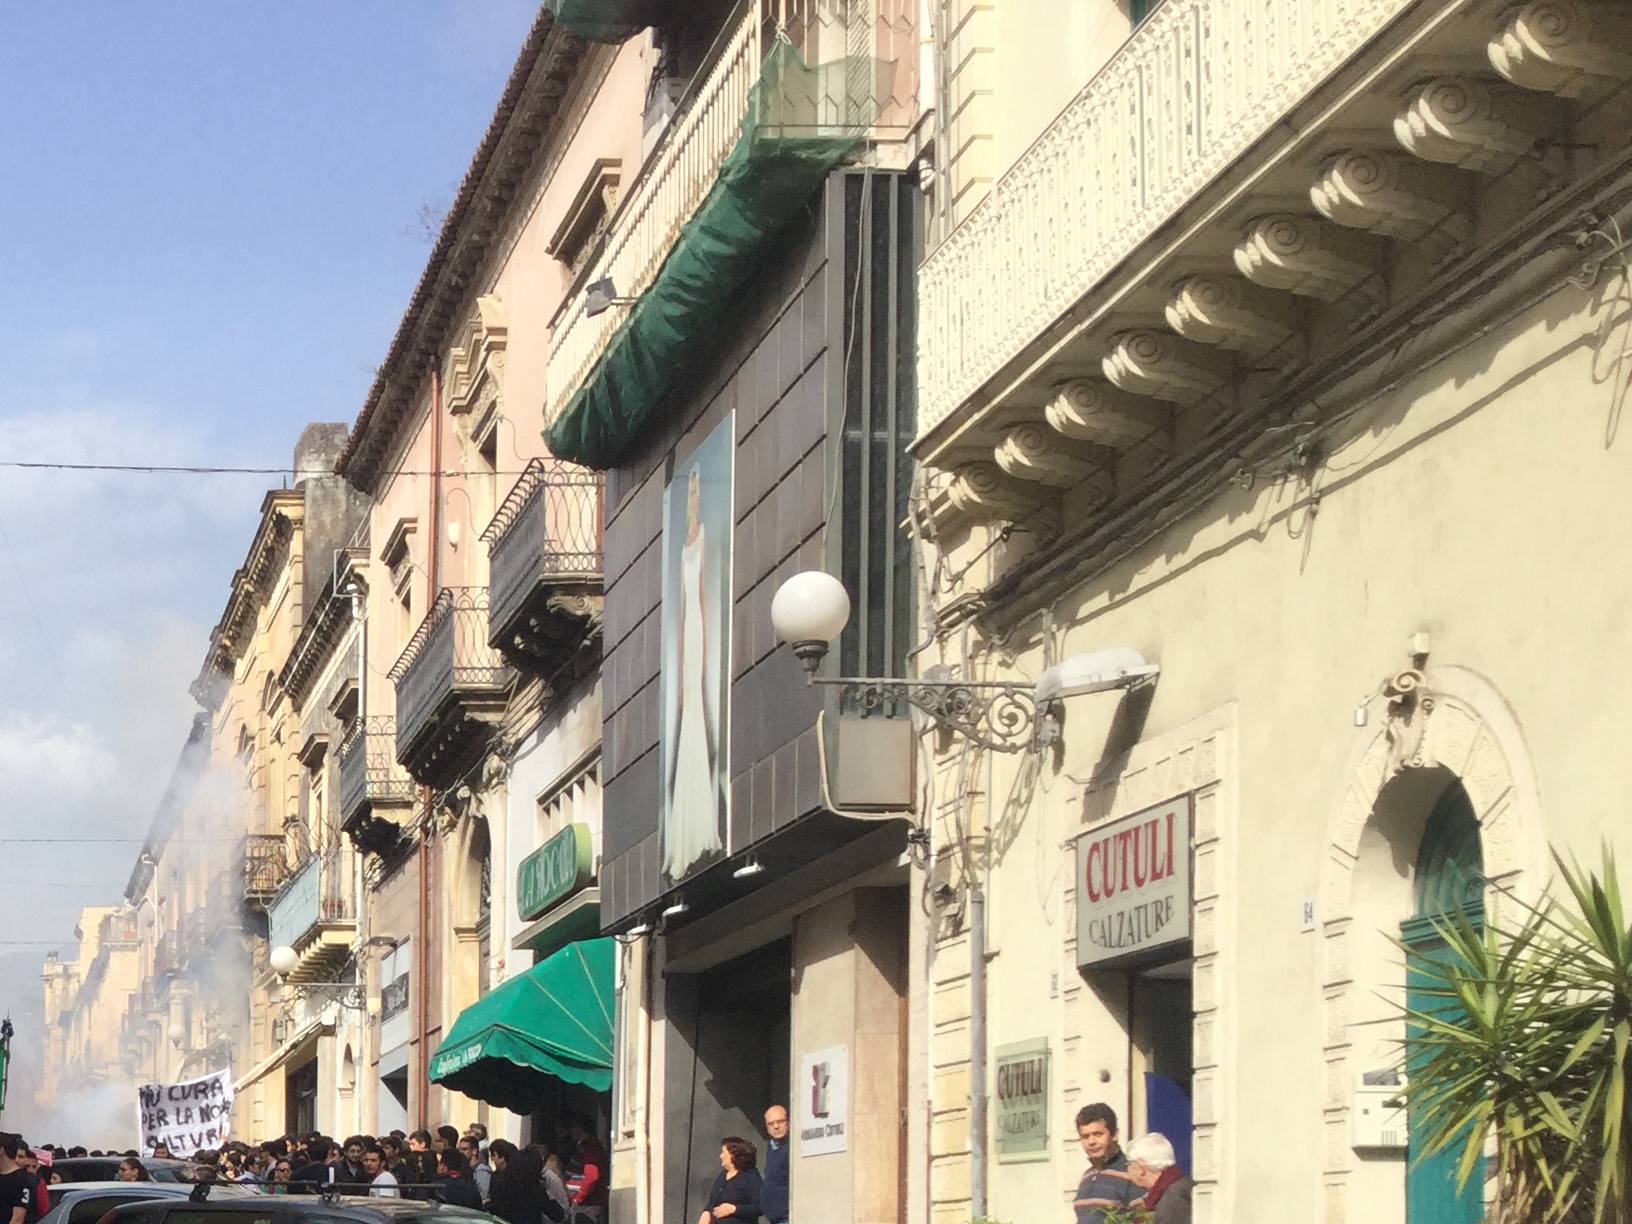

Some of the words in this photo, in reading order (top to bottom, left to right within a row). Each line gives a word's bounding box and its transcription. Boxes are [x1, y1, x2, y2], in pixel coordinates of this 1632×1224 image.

[1086, 812, 1176, 903] CUTULI
[1088, 894, 1176, 949] CALZATURE
[168, 1078, 224, 1102] CURA
[997, 1057, 1042, 1101] CUTULI
[142, 1108, 170, 1131] PER
[176, 1106, 195, 1126] LA
[21, 1188, 30, 1204] 3
